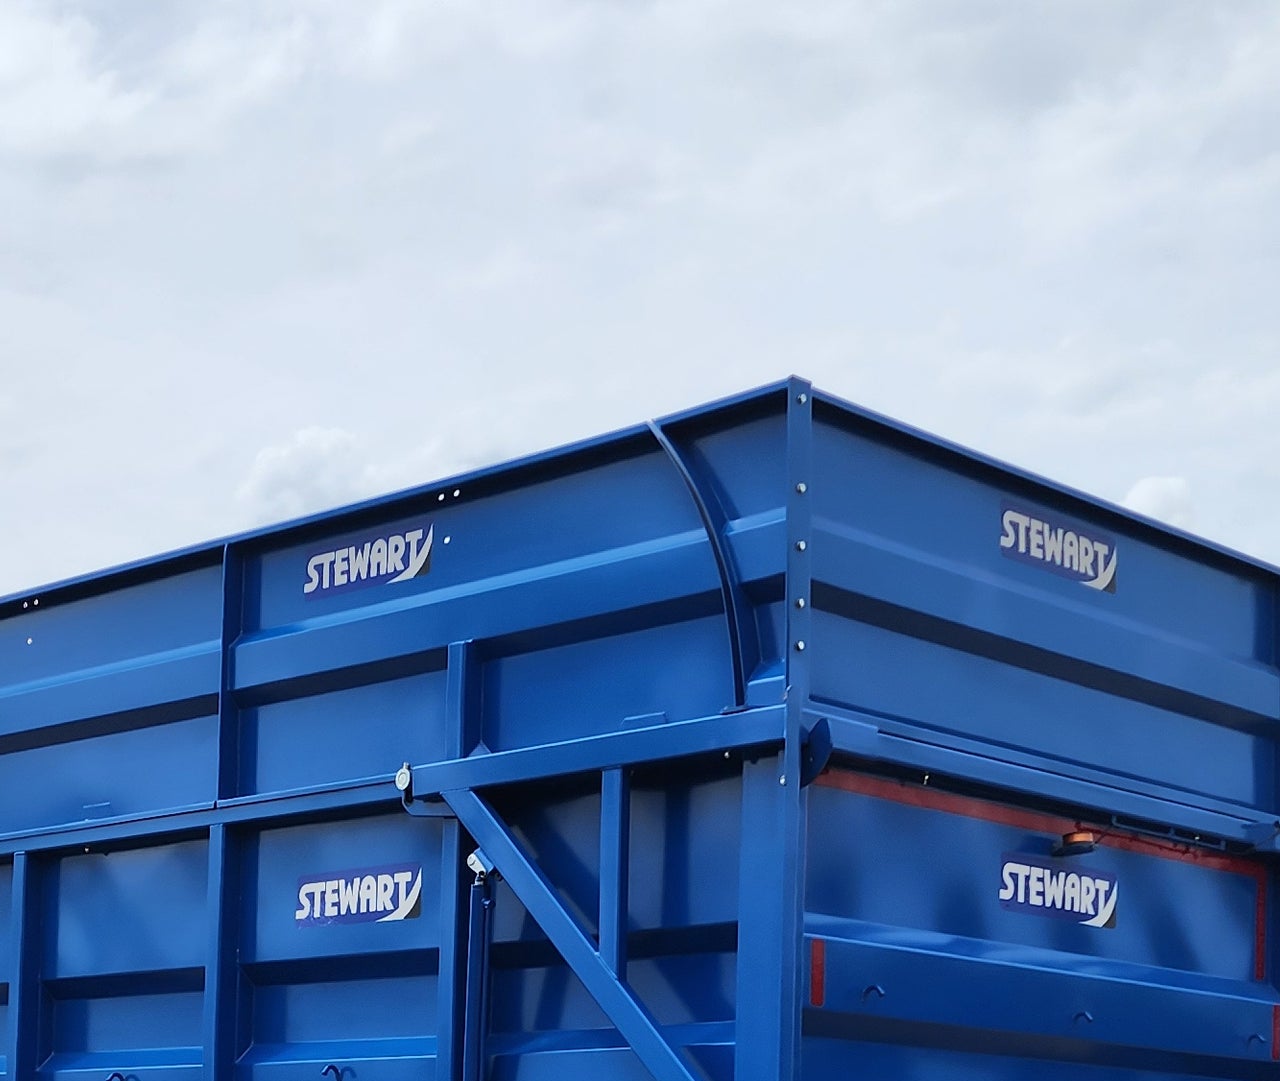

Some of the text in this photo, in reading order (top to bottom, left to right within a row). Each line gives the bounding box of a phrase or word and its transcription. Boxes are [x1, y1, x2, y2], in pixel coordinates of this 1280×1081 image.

[303, 523, 434, 594] STEWART
[999, 509, 1118, 591] STEWART
[295, 867, 422, 923] STEWART
[999, 861, 1118, 928] STEWART
